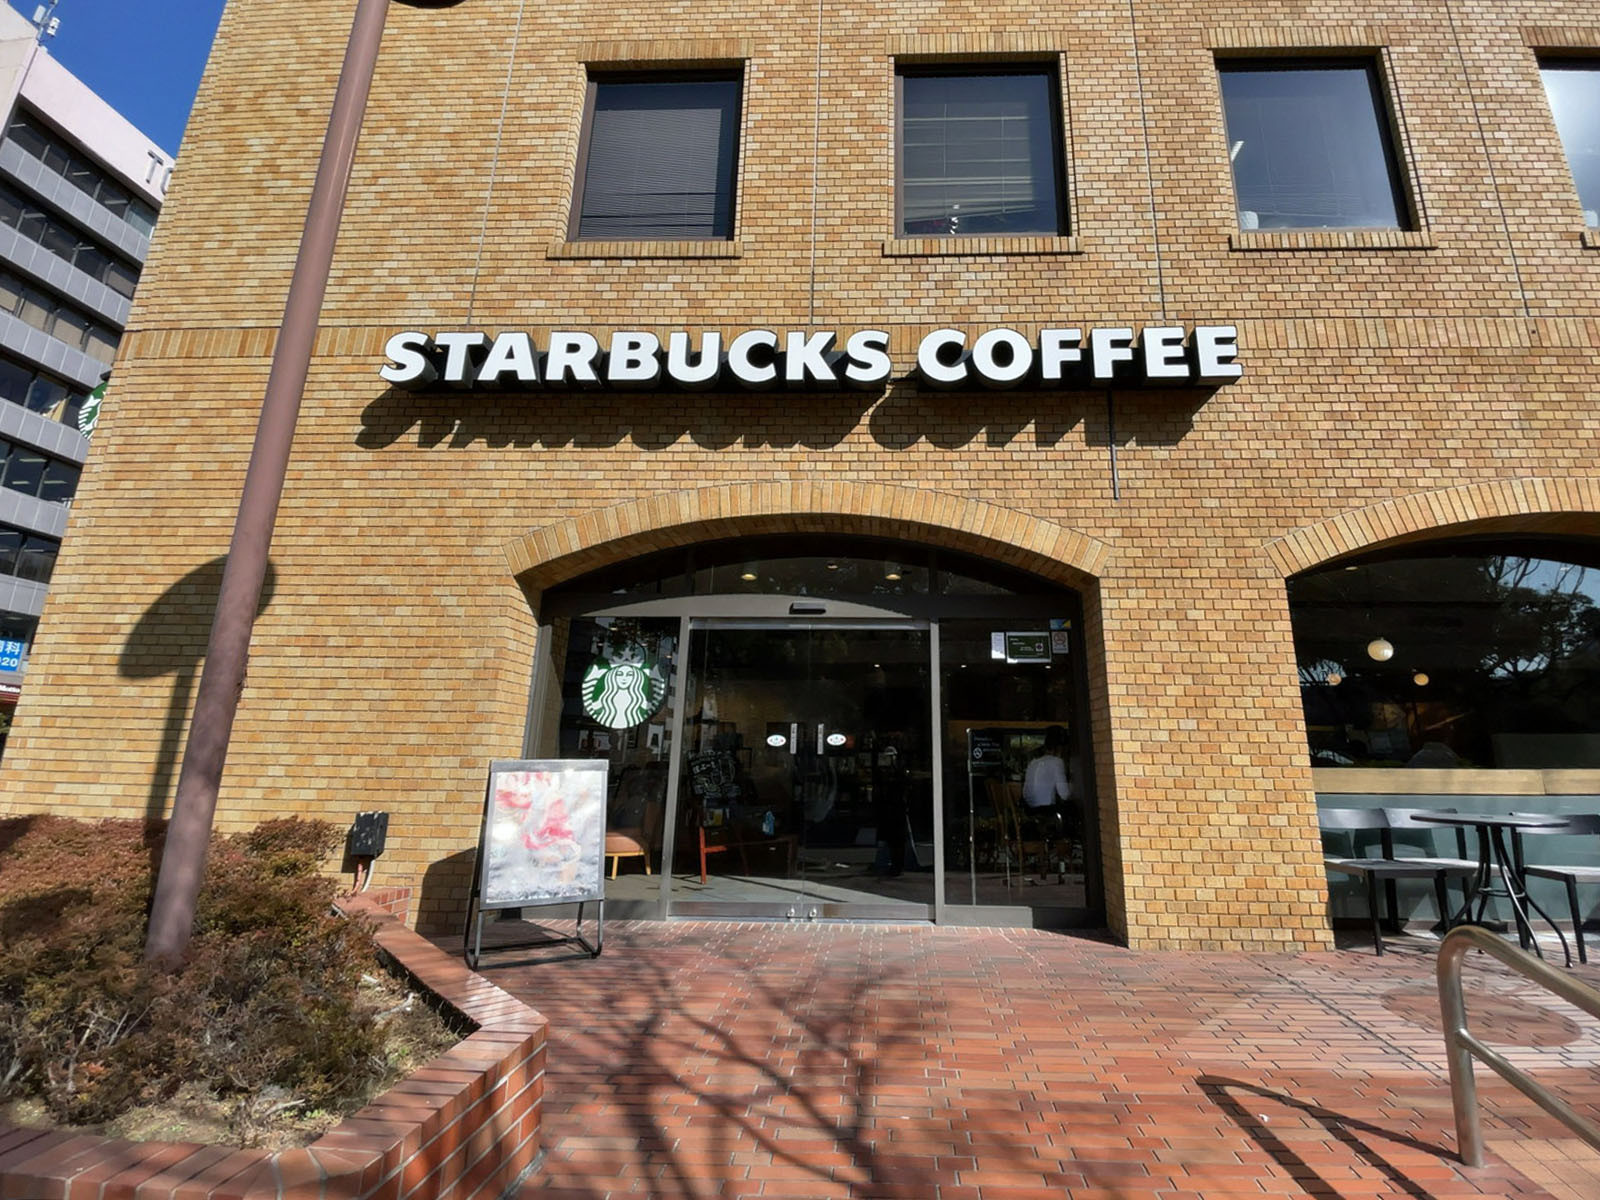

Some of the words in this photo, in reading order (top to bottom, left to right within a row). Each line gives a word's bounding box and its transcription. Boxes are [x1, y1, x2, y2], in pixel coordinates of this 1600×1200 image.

[378, 329, 892, 385] STARBUCKS
[917, 326, 1243, 384] COFFEE
[0, 640, 21, 655] 科
[0, 657, 18, 668] 20
